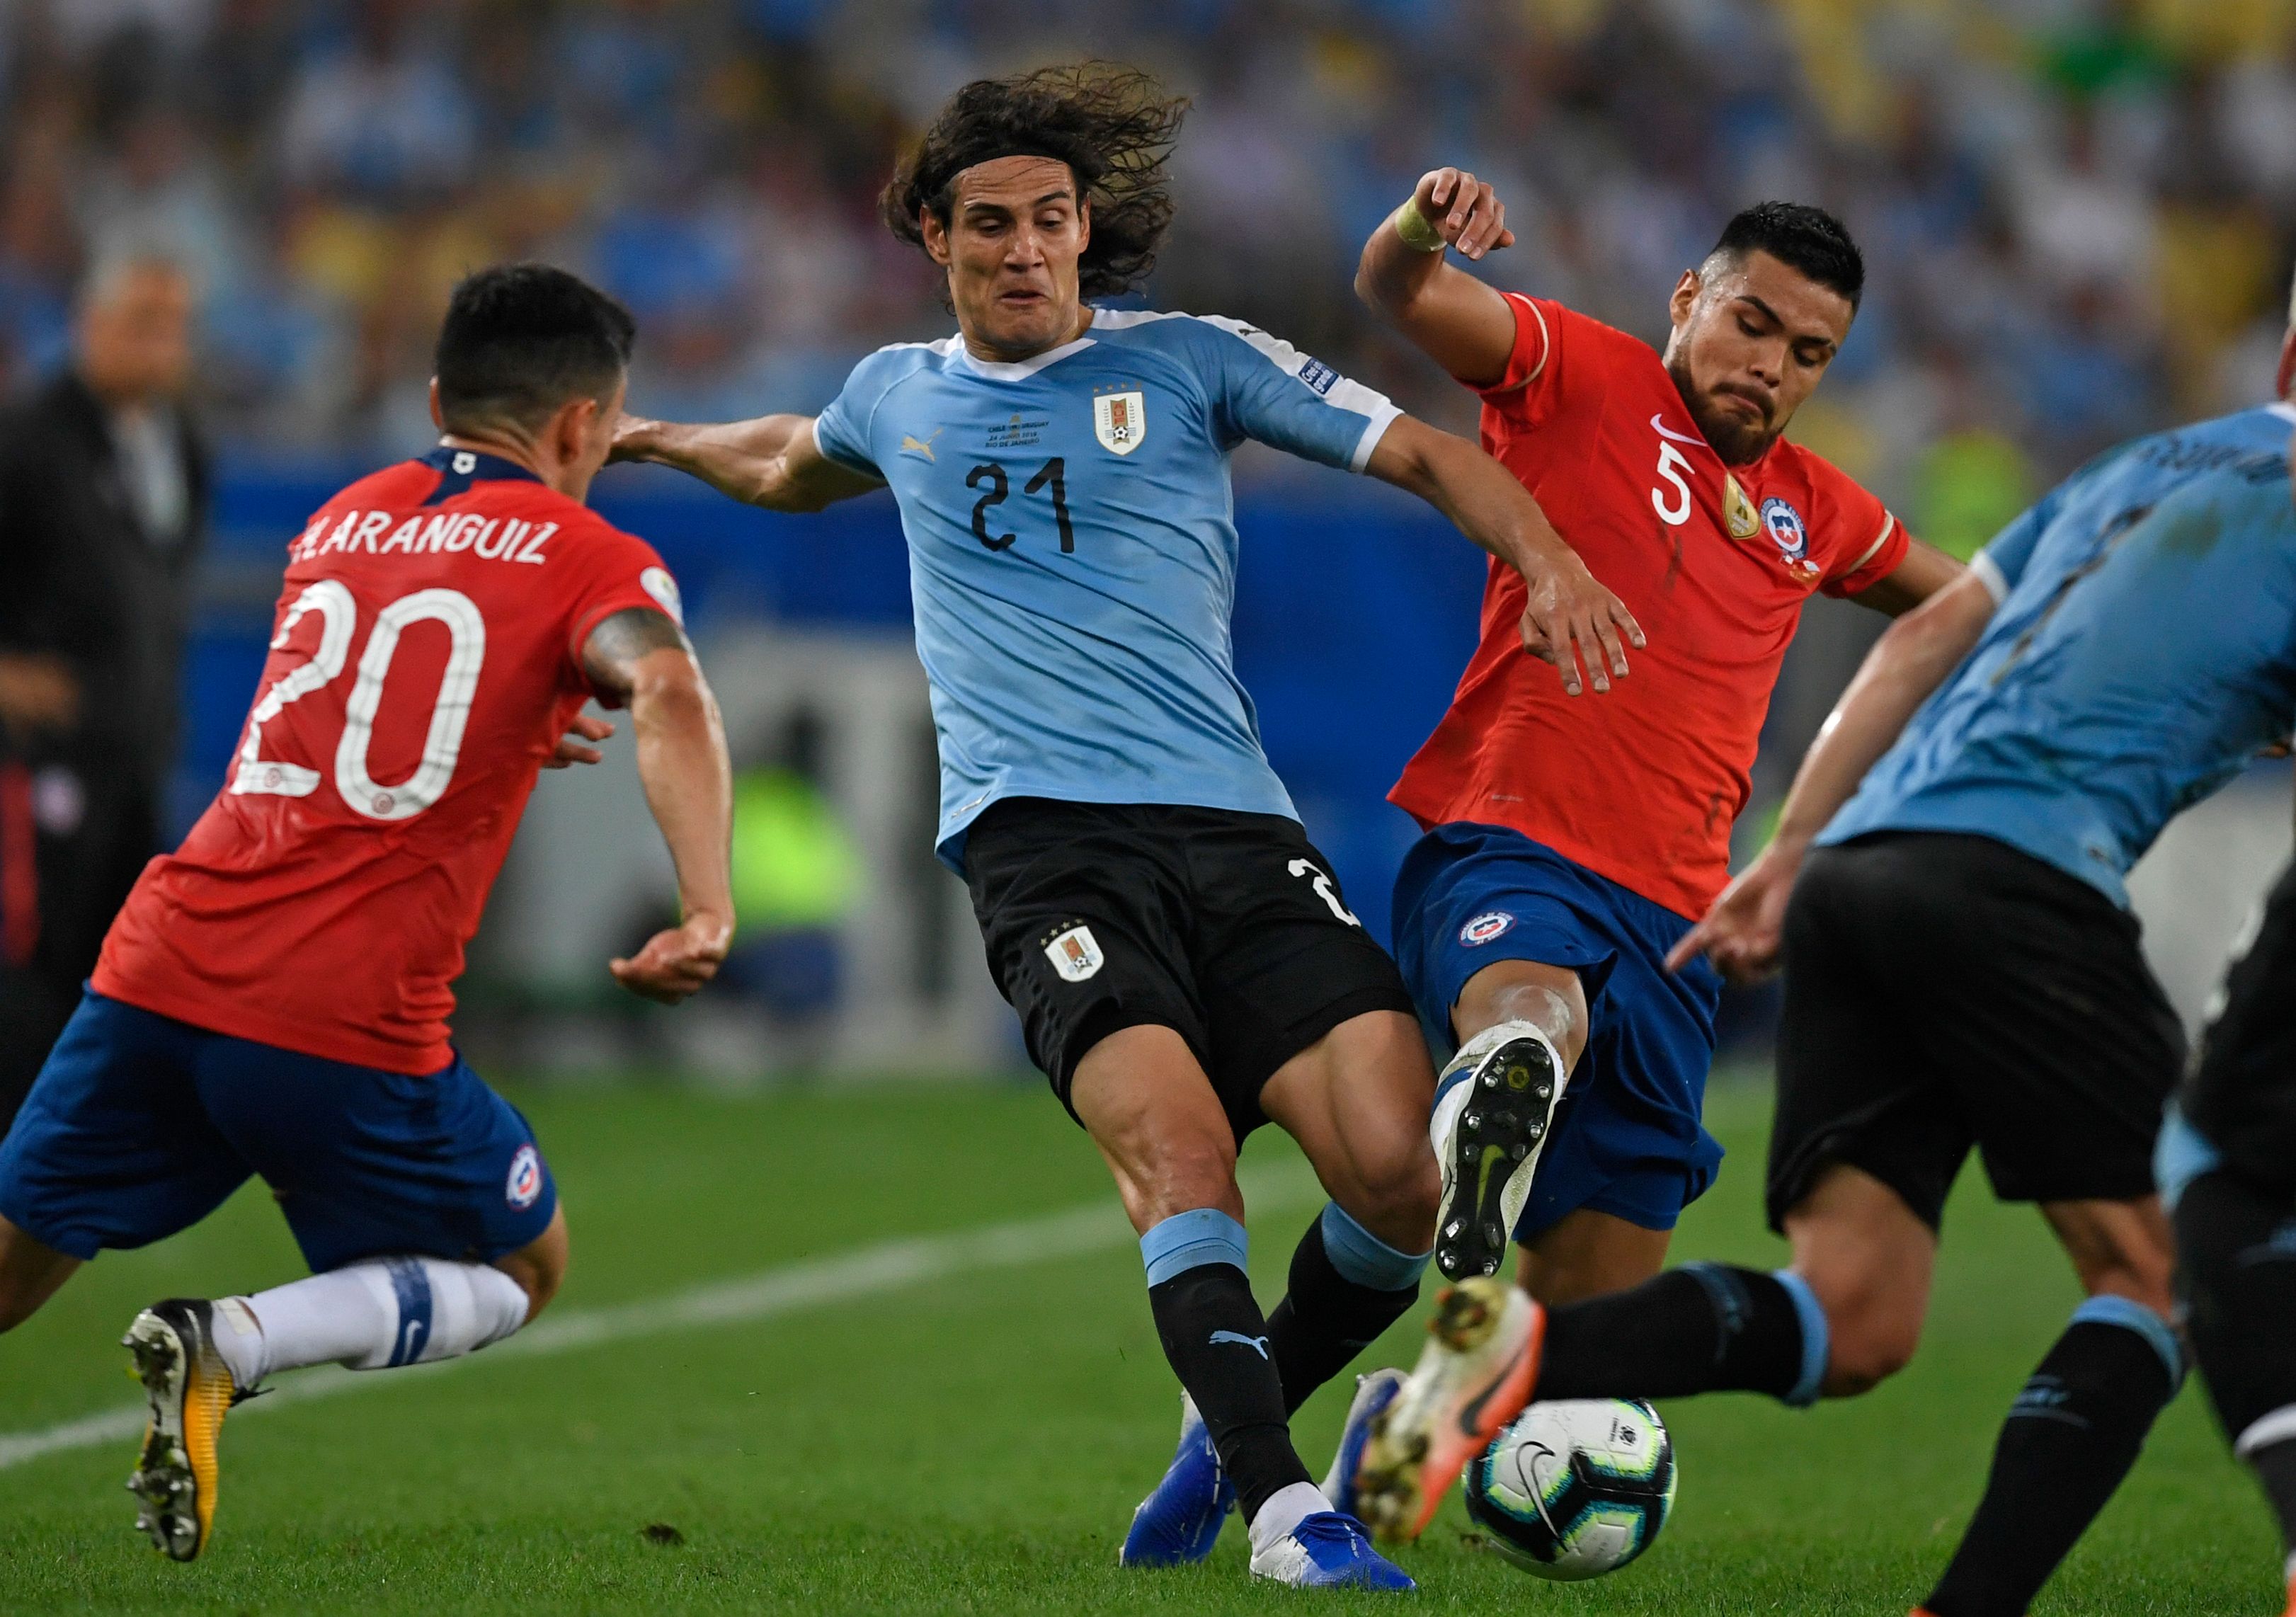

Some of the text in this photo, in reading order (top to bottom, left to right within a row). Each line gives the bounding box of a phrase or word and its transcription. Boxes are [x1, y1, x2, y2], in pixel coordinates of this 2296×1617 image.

[966, 457, 1075, 554] 21
[1651, 440, 1696, 526] 5
[230, 578, 486, 821] 20
